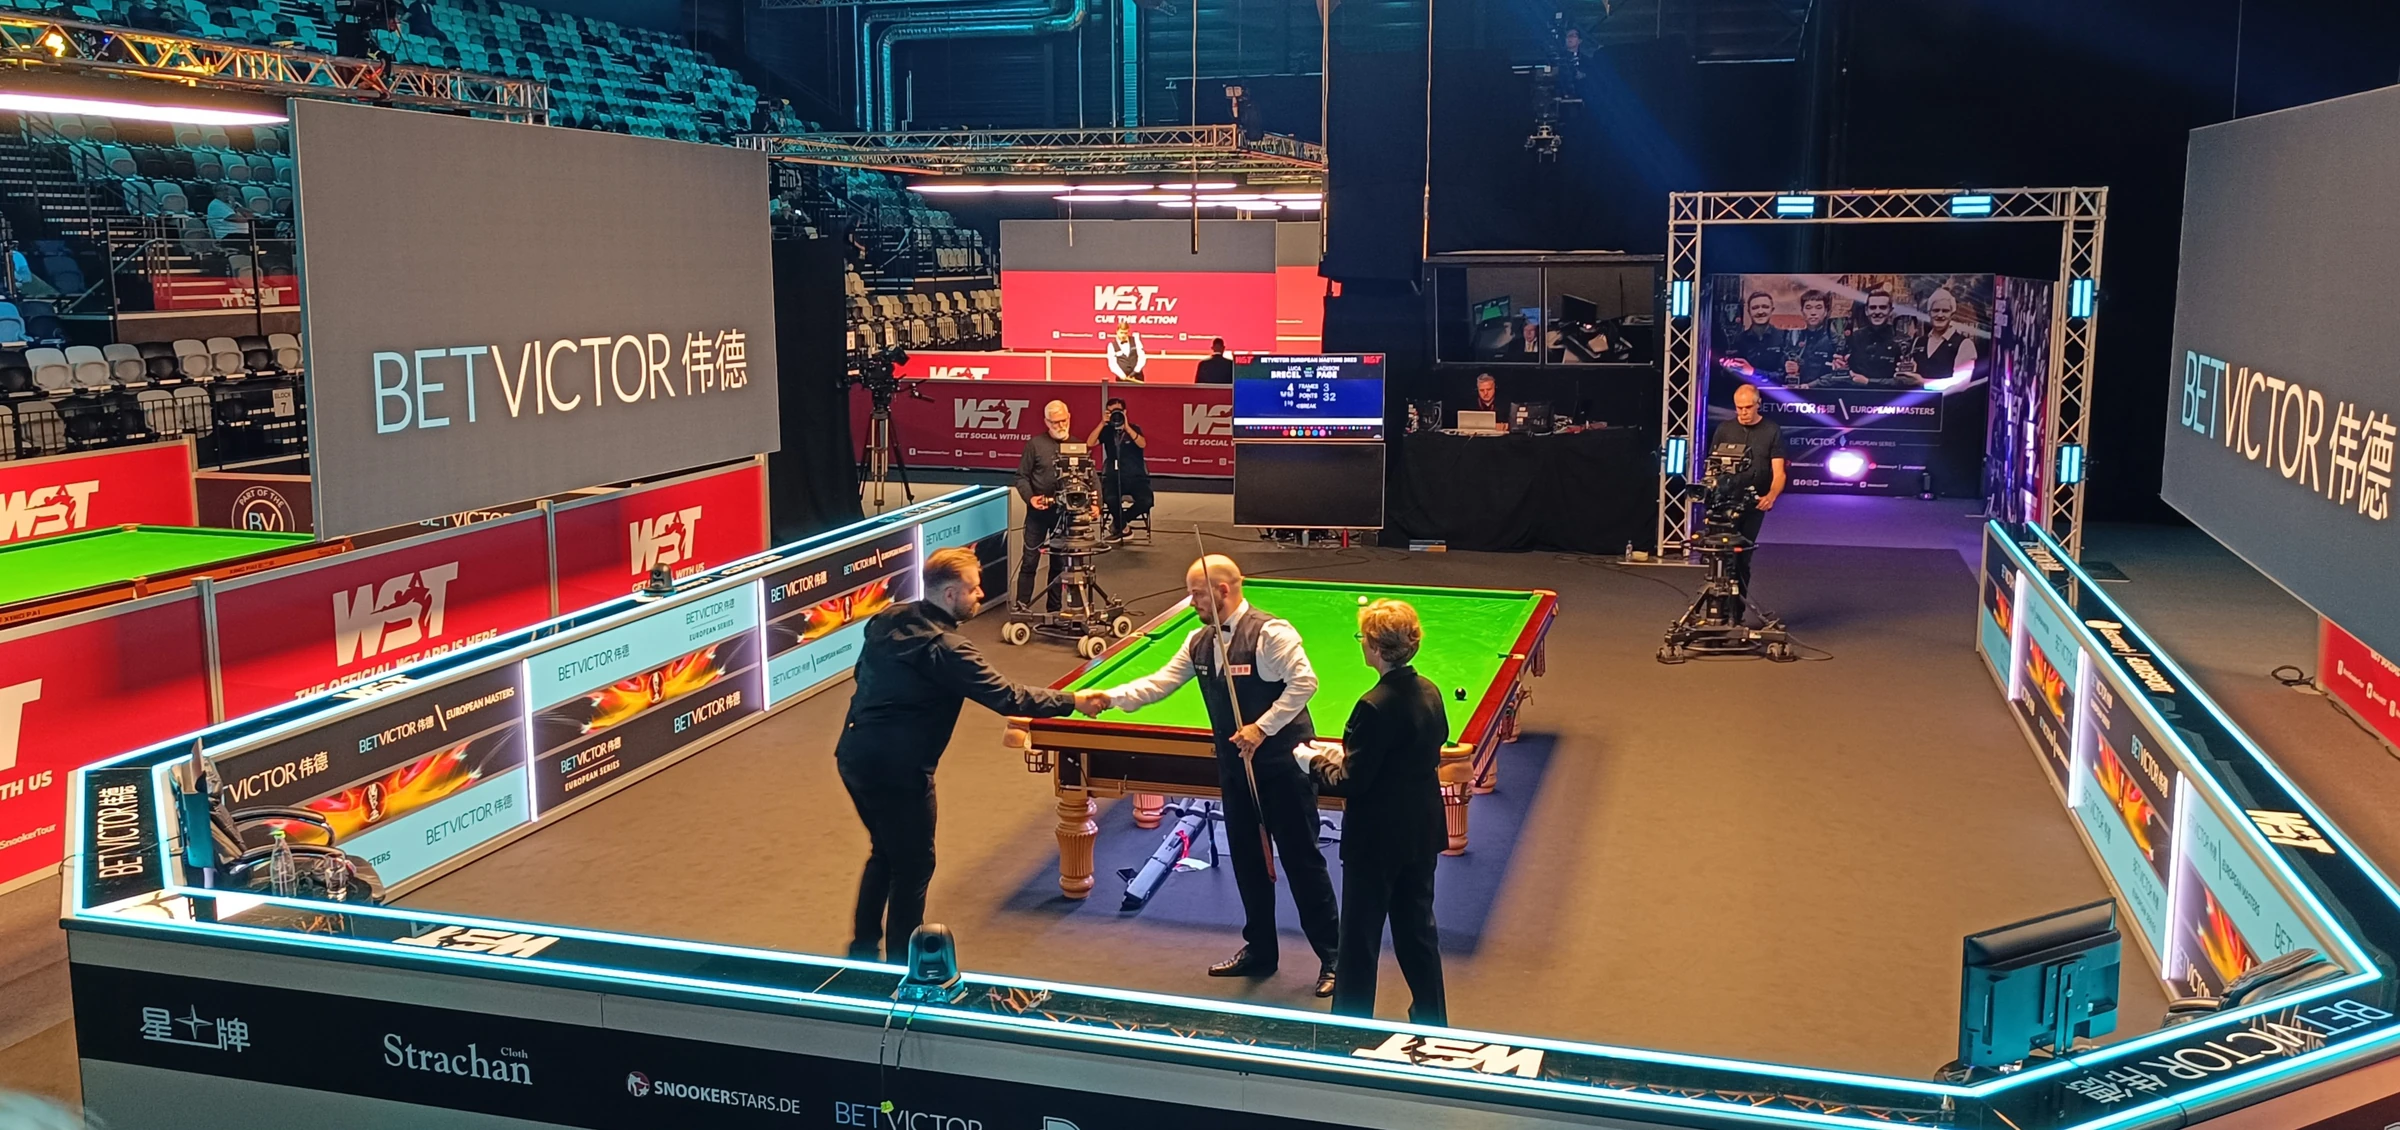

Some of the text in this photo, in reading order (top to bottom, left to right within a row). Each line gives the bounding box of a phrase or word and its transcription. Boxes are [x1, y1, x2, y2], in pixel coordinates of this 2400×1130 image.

[1094, 285, 1178, 311] WST.TV
[1095, 315, 1178, 324] CUE THE ACTION
[373, 328, 748, 434] BETVICTOR 伟德
[1270, 371, 1301, 379] BRECEL
[1316, 371, 1338, 379] PAGE
[1323, 383, 1330, 392] 3
[281, 402, 287, 414] 7
[1323, 393, 1336, 401] 32
[1850, 405, 1896, 414] EUROPEAN
[1896, 406, 1935, 416] MASTERS
[954, 398, 1030, 429] WST
[1183, 403, 1233, 435] WS
[1790, 437, 1836, 446] BETVICTOR
[2181, 350, 2397, 520] BETVICTOR 伟德
[0, 480, 99, 541] WST
[239, 489, 255, 506] PART
[269, 492, 284, 508] THE
[629, 506, 702, 576] WST
[675, 562, 705, 579] WITH US
[770, 576, 815, 603] BETVICTOR
[26, 610, 41, 618] PAI
[332, 561, 459, 666] WST
[686, 602, 723, 625] BETVICTOR
[689, 619, 734, 641] EUROPEAN SERIES
[558, 649, 613, 681] BETVICTOR
[359, 721, 417, 753] BETVICTOR
[446, 698, 483, 720] EUROPEAN
[484, 687, 514, 706] MASTERS
[674, 698, 725, 733] BETVICTOR
[561, 740, 607, 773] BETVICTOR
[28, 770, 53, 791] US
[222, 751, 329, 804] VICTOR 伟德
[564, 759, 620, 791] EUROPEAN SERIES
[426, 794, 513, 845] BETVICTOR 伟德
[0, 824, 56, 849] SnookerTour
[97, 804, 143, 879] BETVICTOR
[391, 925, 560, 958] WST
[140, 1004, 252, 1053] 星牌
[2140, 999, 2393, 1080] BETVICTOR
[383, 1033, 533, 1086] Strachan
[500, 1046, 529, 1060] Cloth
[1351, 1033, 1545, 1079] WST
[654, 1080, 800, 1115] SNOOKERSTARS.DE
